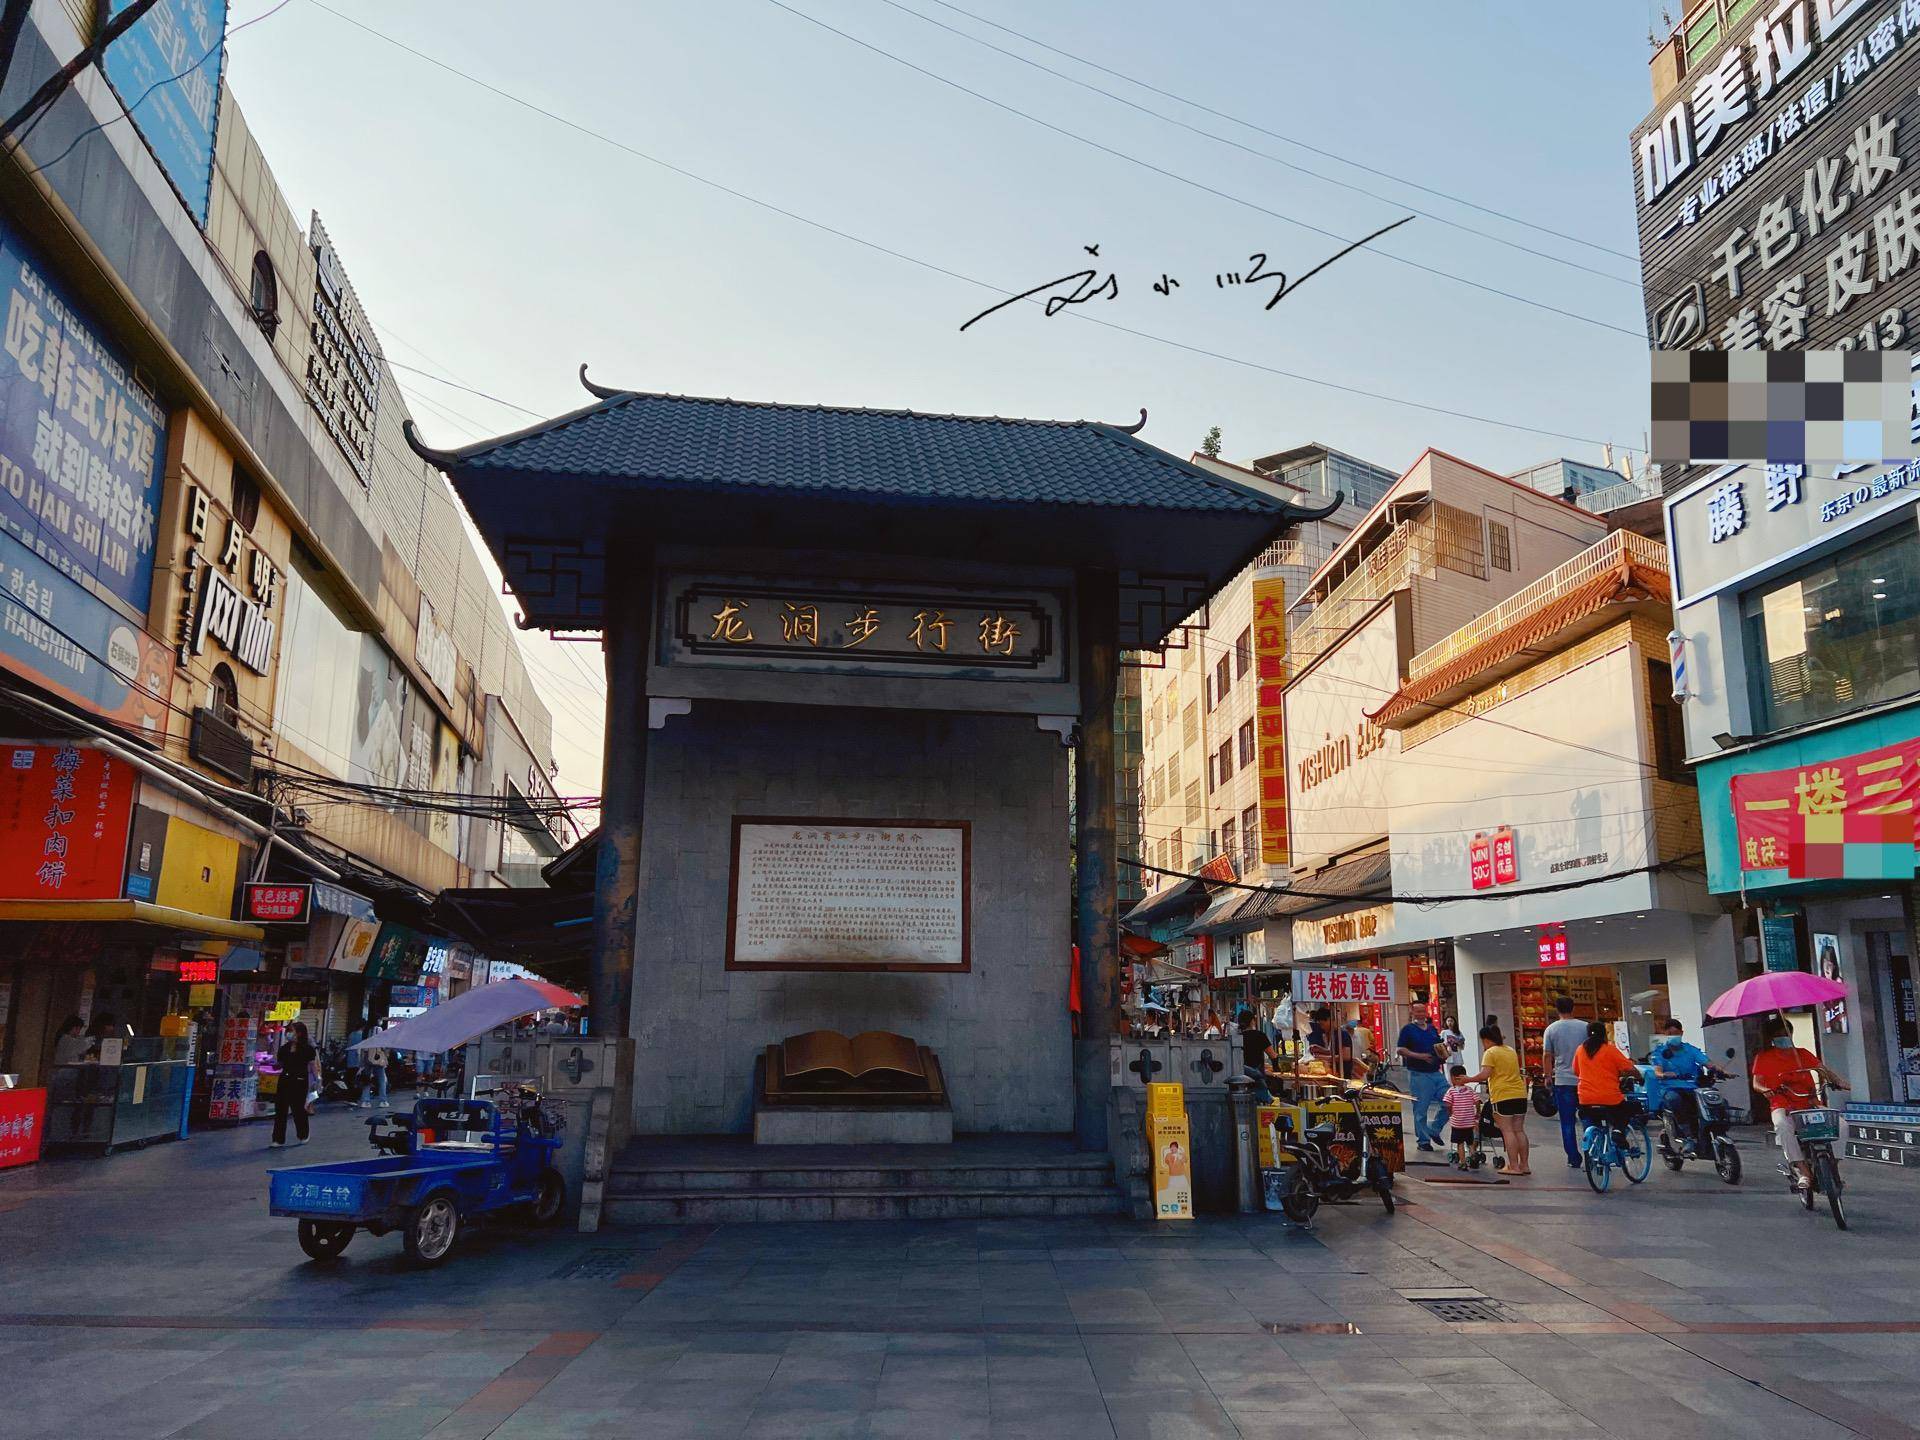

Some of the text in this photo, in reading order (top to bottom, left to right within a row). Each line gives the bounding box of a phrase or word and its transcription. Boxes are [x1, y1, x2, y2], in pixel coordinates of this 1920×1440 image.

[1712, 113, 1901, 300] 千色化妆
[5, 287, 156, 489] 吃韩式炸鸡
[21, 261, 166, 431] EAT KOREAN FRIED CHICKEN
[0, 454, 24, 499] TO
[29, 478, 70, 534] HAN
[73, 513, 101, 557] SHI
[102, 534, 128, 576] LIN
[32, 409, 154, 554] 就到韩拾林
[187, 486, 271, 603] 日月明
[4, 604, 87, 674] HANSHILIN
[194, 565, 275, 678] 网咖
[709, 599, 1023, 656] 龙洞步行街
[36, 743, 84, 889] 梅菜扣肉饼
[1744, 755, 1920, 816] 一楼三
[254, 888, 300, 904] 黑色经典
[1308, 972, 1391, 1000] 铁板鱿鱼
[213, 1079, 241, 1100] 修表
[289, 1183, 351, 1201] 龙洞台铃
